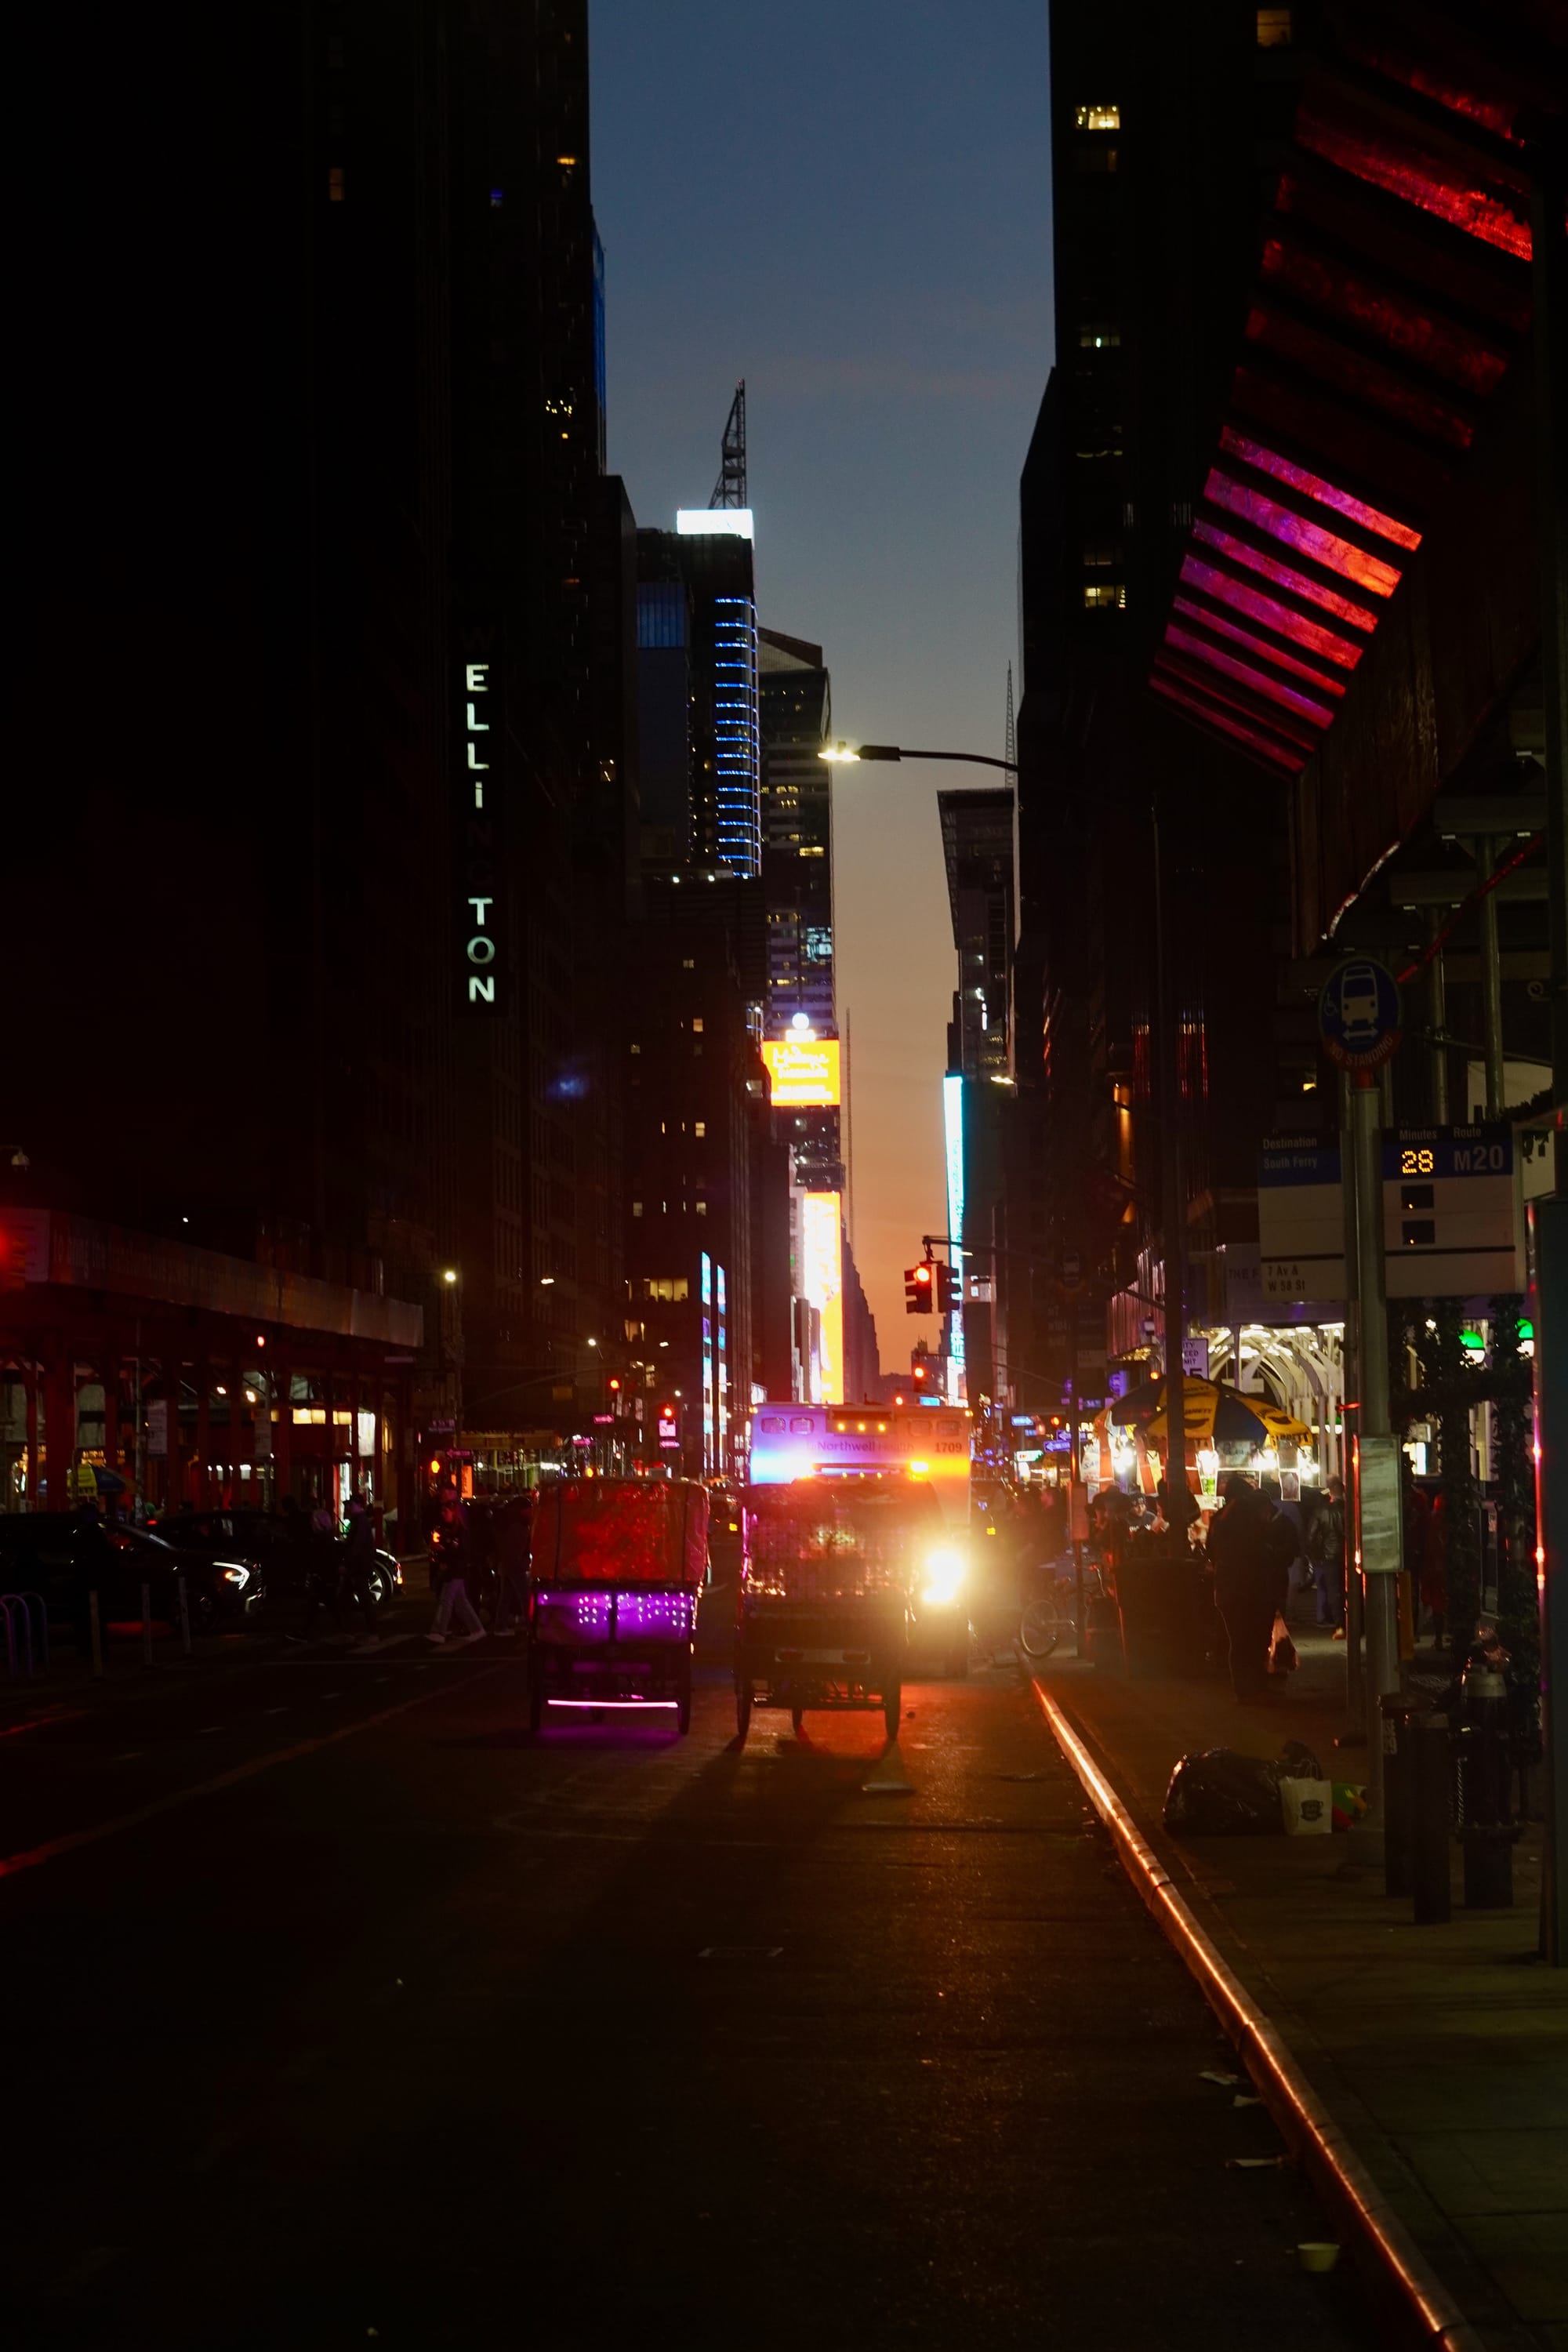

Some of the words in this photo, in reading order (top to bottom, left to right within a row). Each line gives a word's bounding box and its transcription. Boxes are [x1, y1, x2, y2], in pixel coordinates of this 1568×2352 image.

[1345, 1034, 1394, 1067] STANDING
[1399, 1127, 1438, 1142] Minutes
[1453, 1126, 1482, 1138] Route
[1262, 1136, 1317, 1150] Destination
[1263, 1156, 1290, 1171] South
[1401, 1149, 1434, 1174] 28
[1454, 1144, 1504, 1172] M20
[1268, 1265, 1273, 1276] 7
[1277, 1264, 1288, 1276] Av
[1268, 1279, 1278, 1292] W
[1295, 1278, 1305, 1292] St
[817, 1440, 876, 1452] Northwell
[935, 1441, 963, 1453] 1709
